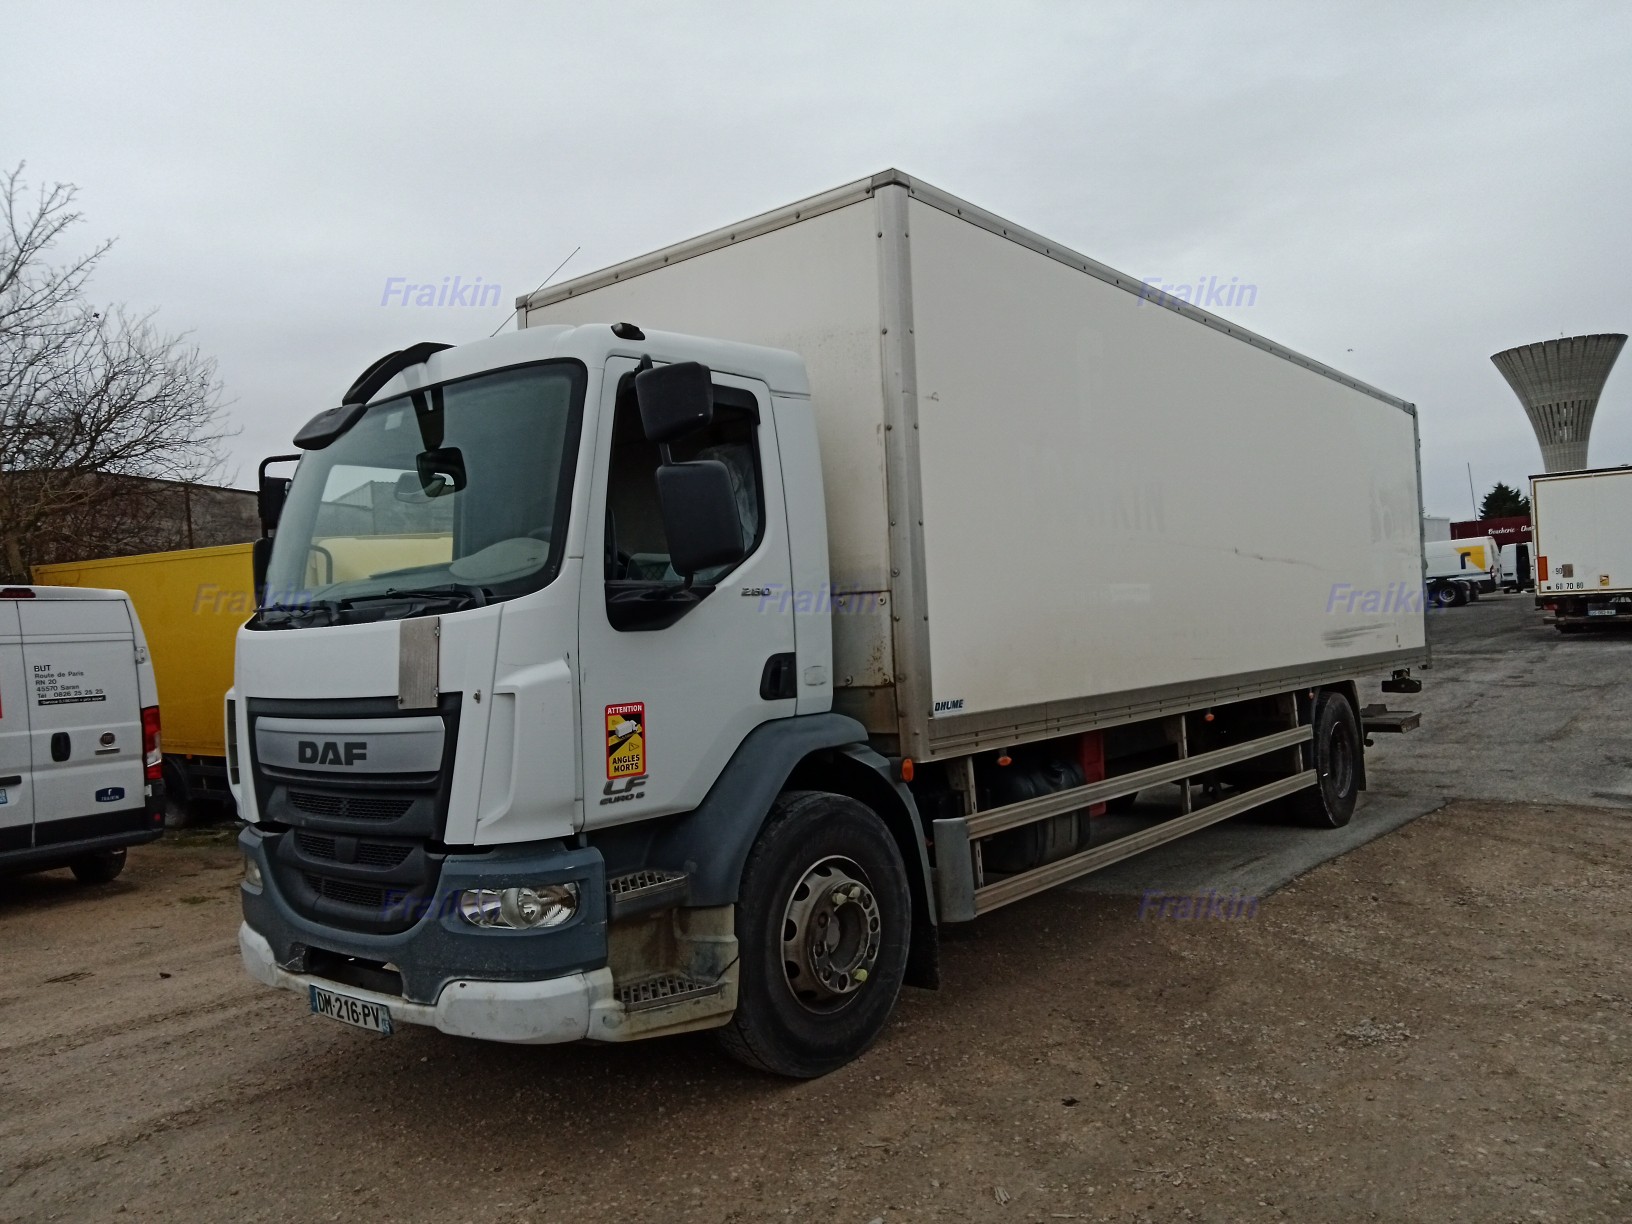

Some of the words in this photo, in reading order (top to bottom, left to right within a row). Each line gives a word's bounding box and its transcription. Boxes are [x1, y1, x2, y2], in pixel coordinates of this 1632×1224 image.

[1566, 582, 1573, 590] 70
[607, 705, 642, 714] ATTENTION
[935, 699, 963, 711] DHUME
[298, 740, 368, 766] DAF
[612, 754, 640, 765] ANGLES
[613, 762, 639, 773] MORTS
[603, 774, 649, 796] LF
[599, 793, 634, 806] EURO
[635, 791, 645, 799] 6
